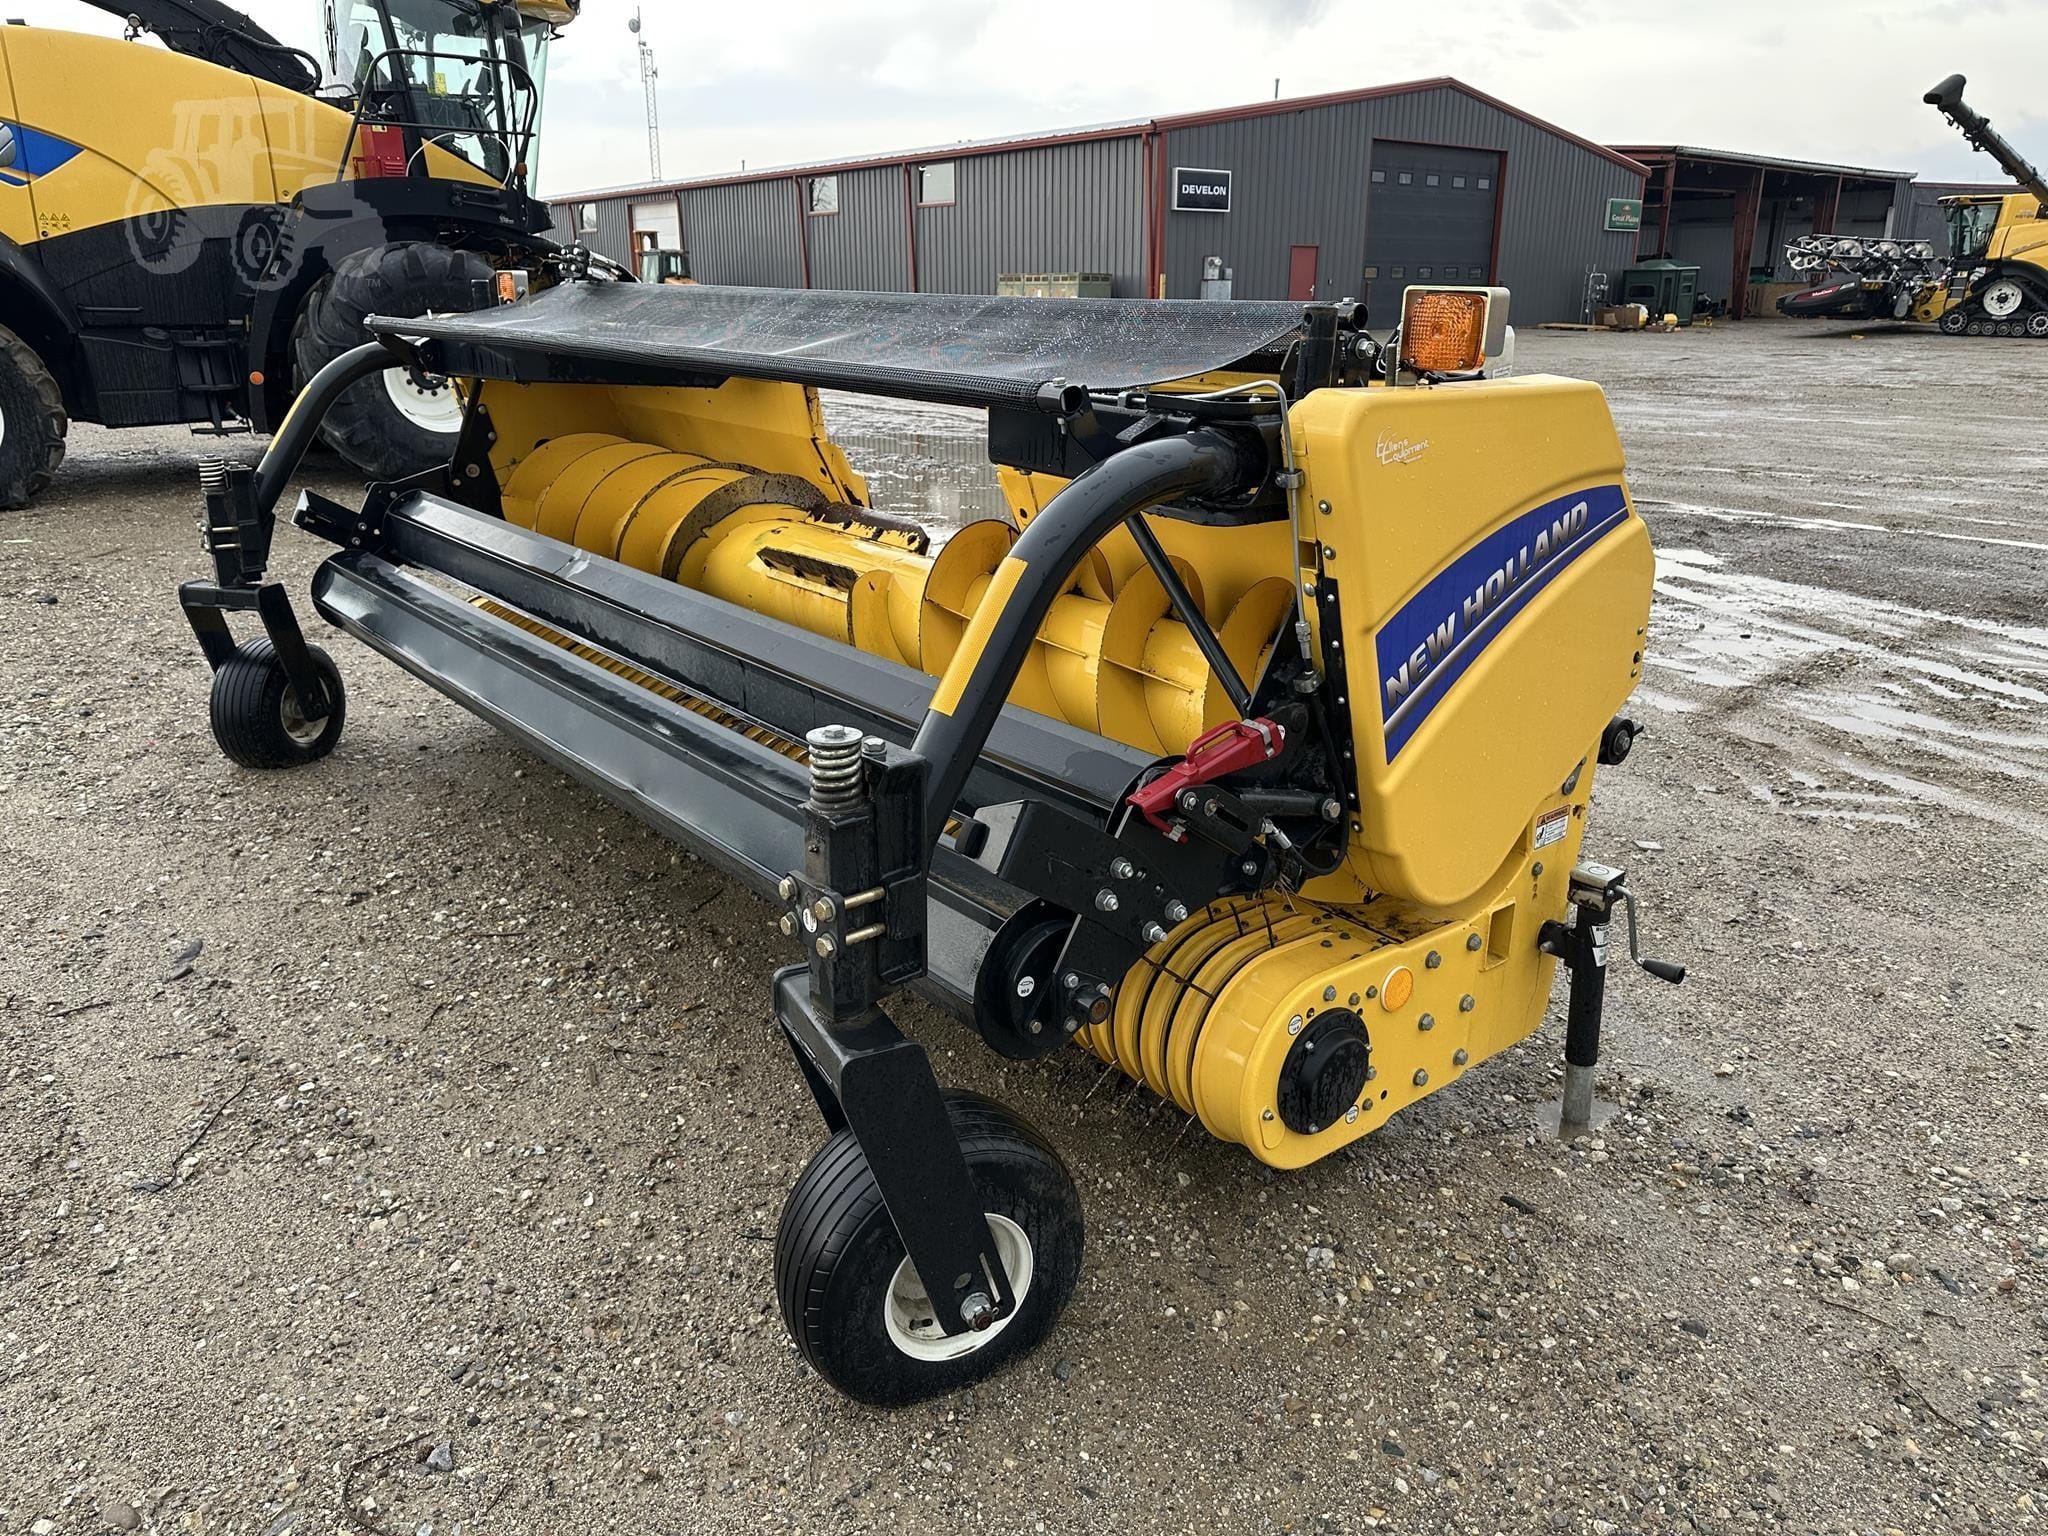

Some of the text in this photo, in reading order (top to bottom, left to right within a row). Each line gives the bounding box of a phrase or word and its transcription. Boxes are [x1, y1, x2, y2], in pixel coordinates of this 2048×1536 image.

[1182, 184, 1227, 196] DEVELON
[1386, 501, 1589, 708] NEW HOLLAND
